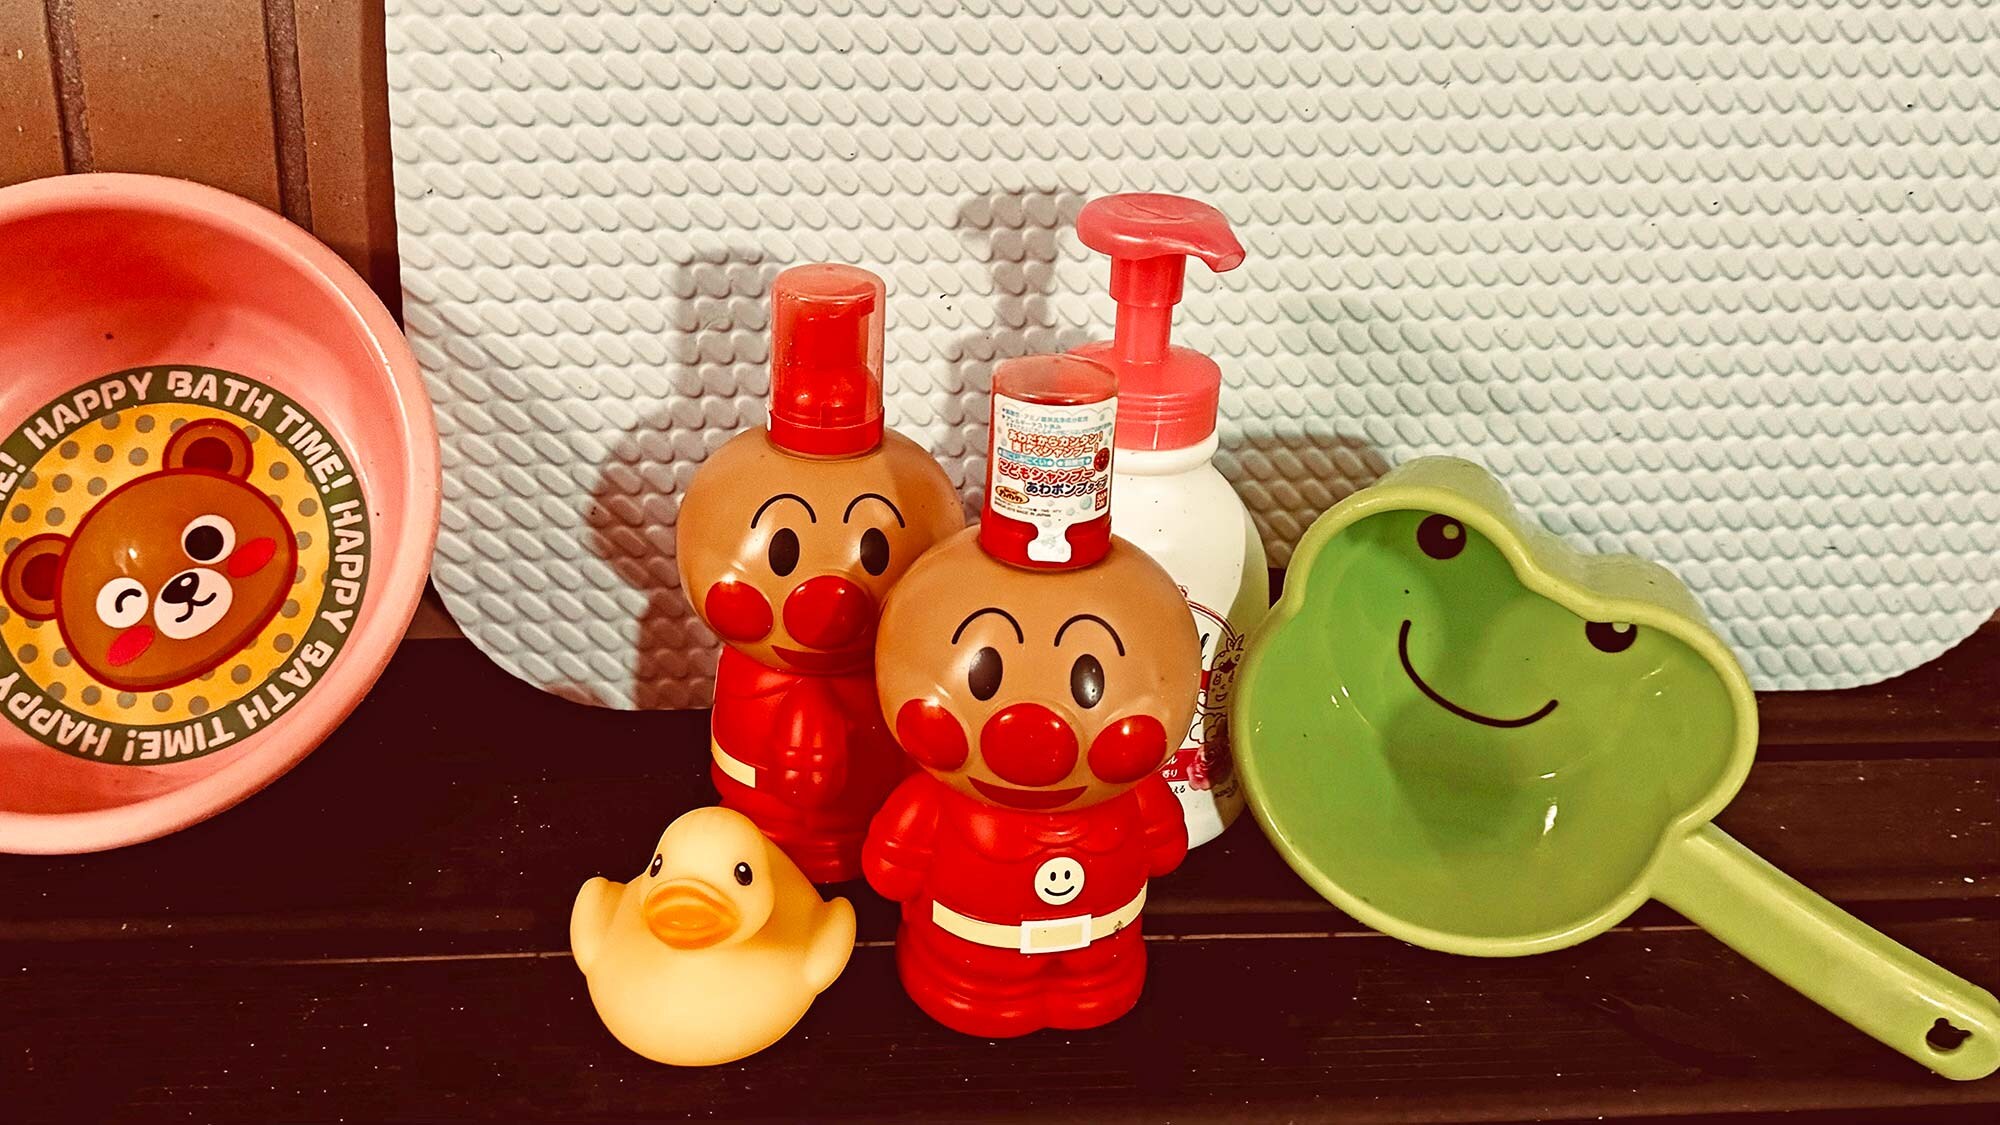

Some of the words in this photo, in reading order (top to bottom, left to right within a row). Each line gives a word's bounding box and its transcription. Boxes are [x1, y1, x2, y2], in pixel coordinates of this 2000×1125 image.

[24, 372, 153, 449] HAPPY
[168, 371, 274, 418] BATH
[274, 406, 353, 493] TIME!
[999, 459, 1095, 483] こどもシャンプー
[321, 500, 363, 633] HAPPY
[0, 672, 112, 756] HAPPY
[239, 642, 335, 728] BATH
[123, 716, 235, 760] TIME!
